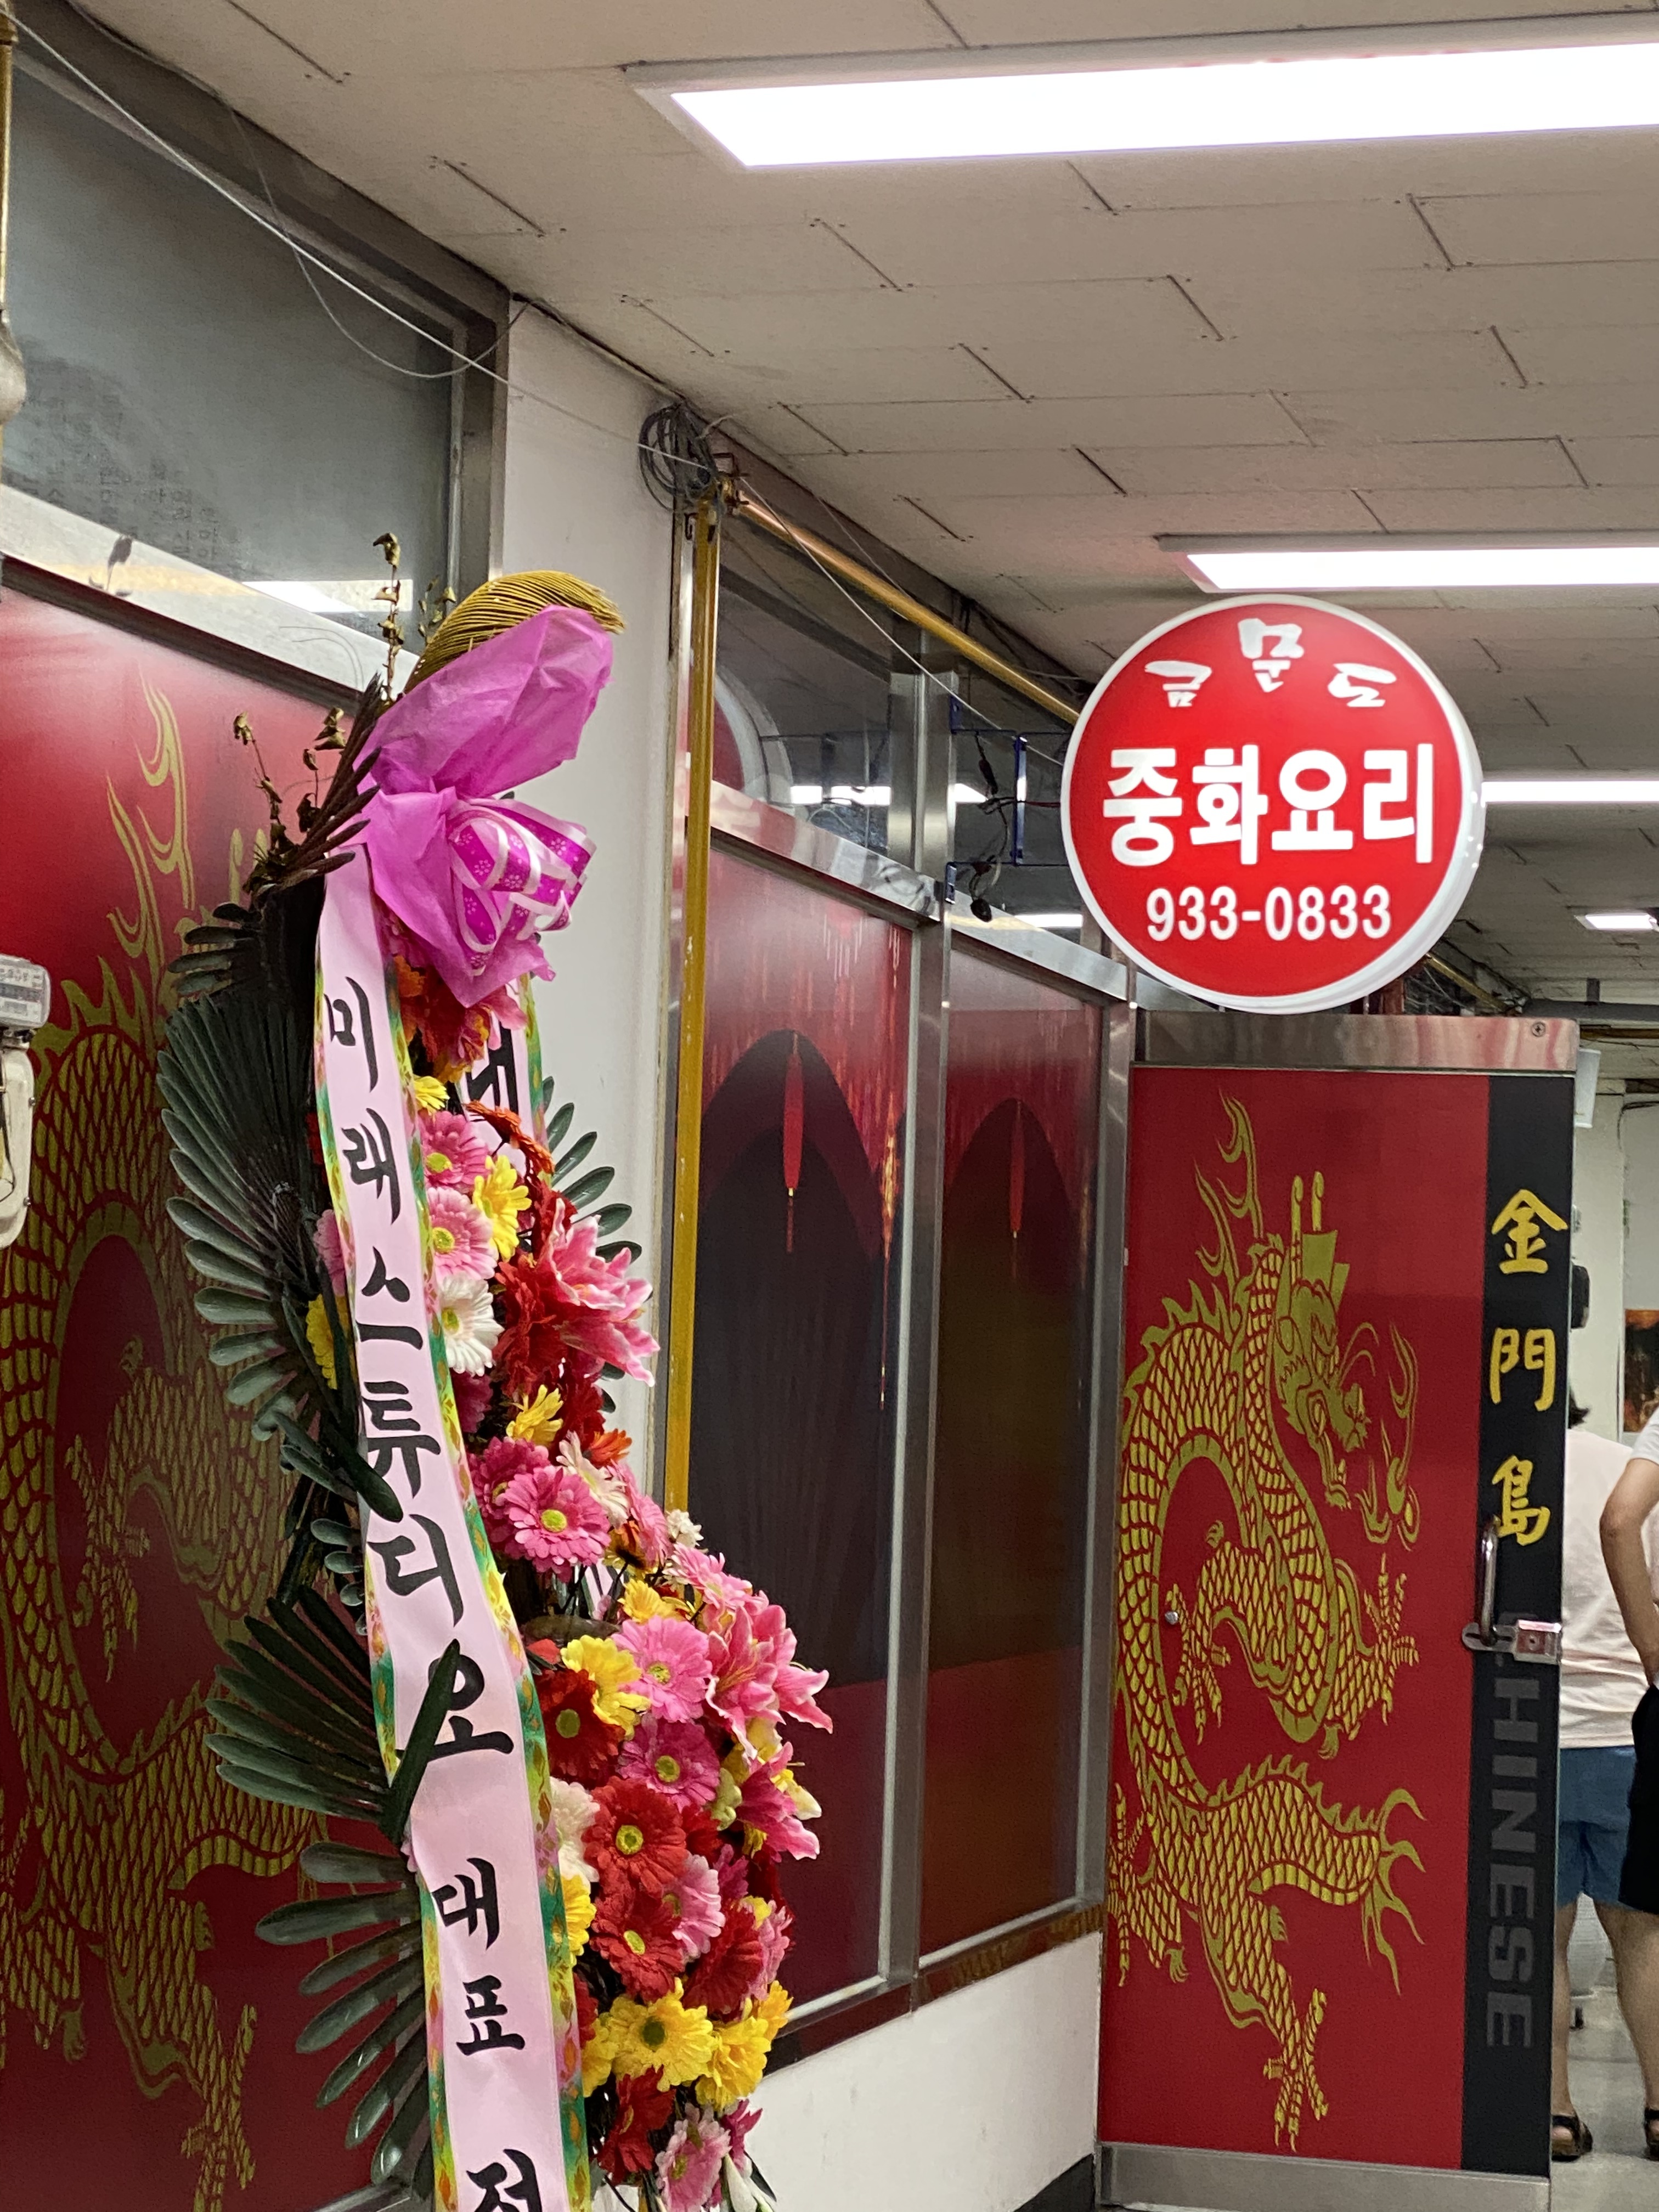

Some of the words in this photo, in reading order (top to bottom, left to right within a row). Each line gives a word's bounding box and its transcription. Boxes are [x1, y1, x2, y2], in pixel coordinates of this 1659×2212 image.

[1144, 618, 1397, 708] 금문도
[1102, 743, 1434, 867] 중화요리
[1146, 885, 1392, 942] 933-0833
[1490, 1189, 1568, 1547] 金門島
[431, 1857, 526, 2056] 대표
